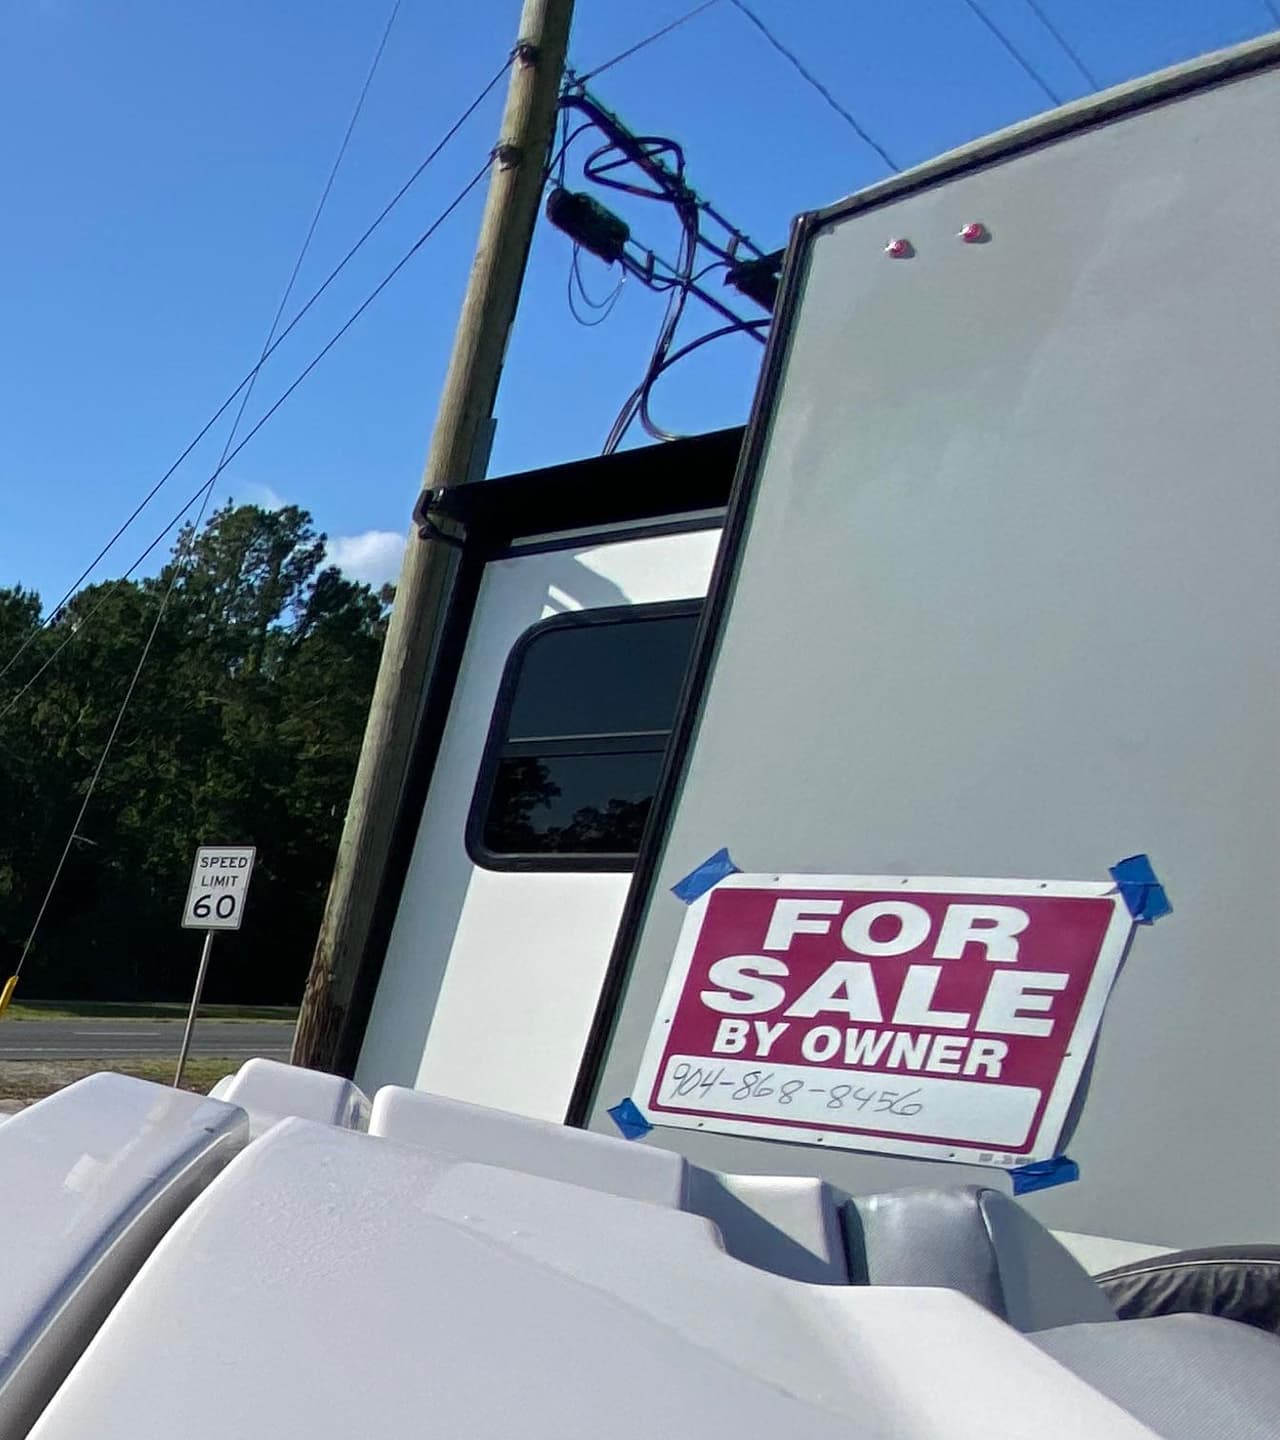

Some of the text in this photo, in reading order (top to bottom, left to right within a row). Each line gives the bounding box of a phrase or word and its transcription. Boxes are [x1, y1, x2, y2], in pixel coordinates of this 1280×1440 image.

[200, 856, 248, 868] SPEED
[201, 875, 239, 887] LIMIT
[193, 894, 236, 919] 60
[762, 898, 1030, 962] FOR
[700, 954, 1070, 1037] SALE
[712, 1017, 1009, 1078] BY OWNER
[670, 1063, 923, 1116] 904-868-8456
